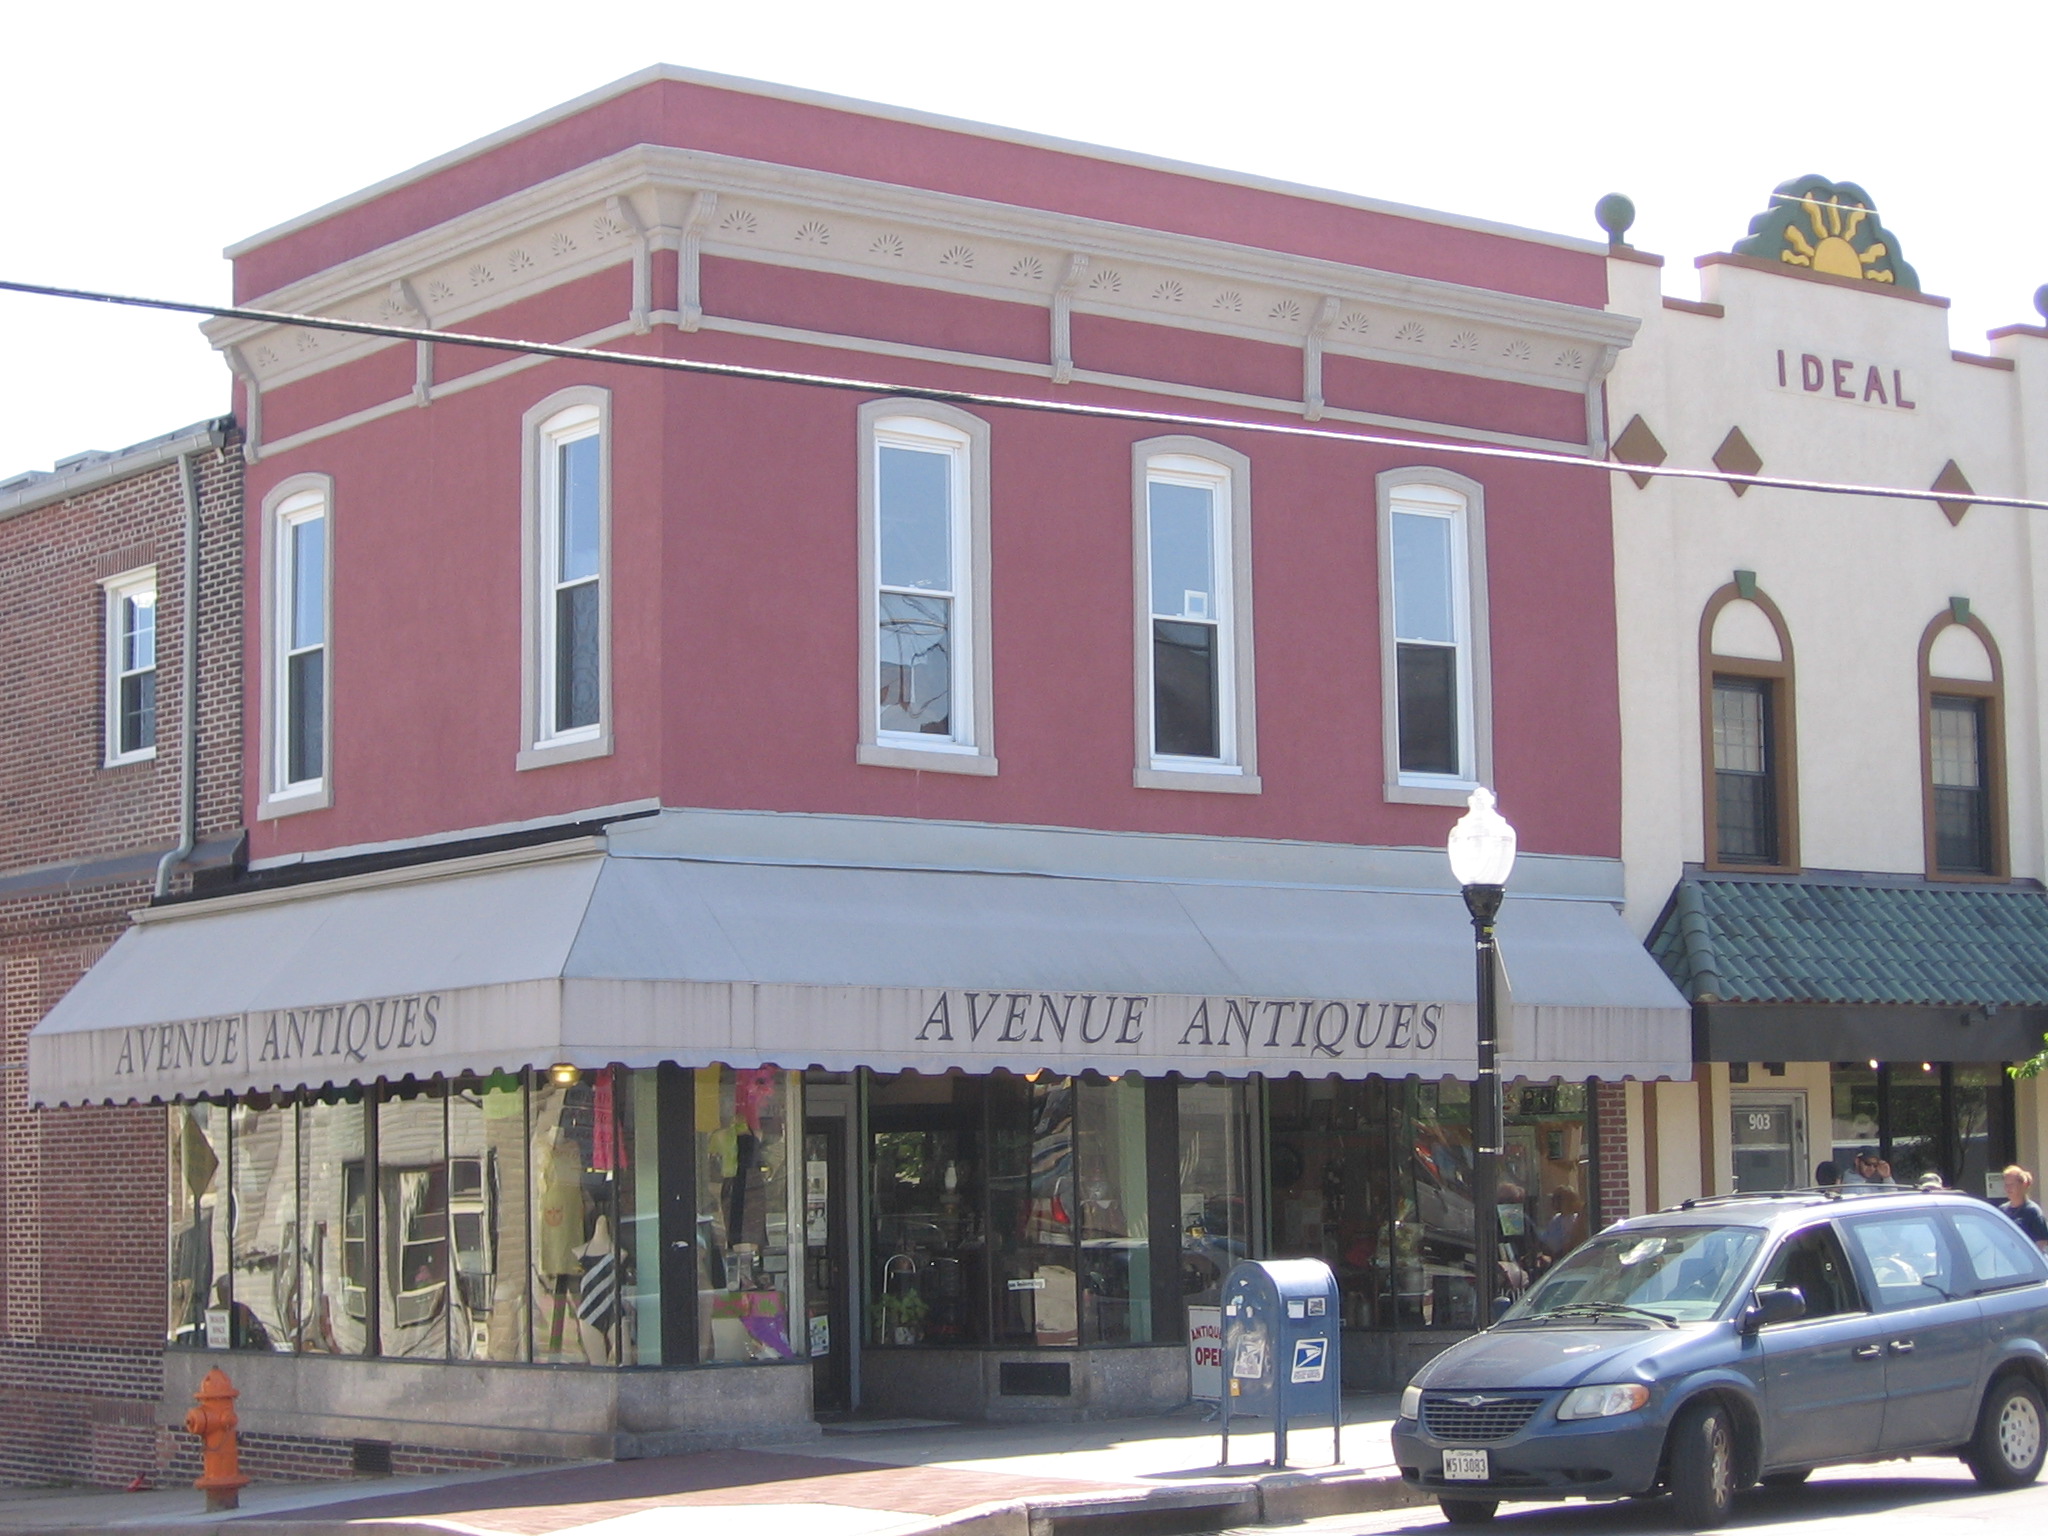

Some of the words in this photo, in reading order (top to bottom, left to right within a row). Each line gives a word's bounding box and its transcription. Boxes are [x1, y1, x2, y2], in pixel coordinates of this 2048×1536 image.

[1777, 349, 1916, 410] IDEAL
[114, 1015, 241, 1075] AVENUE
[258, 995, 441, 1063] ANTIQUES
[915, 991, 1149, 1043] AVENUE
[1178, 997, 1444, 1057] ANTIQUES
[1749, 1113, 1771, 1130] 903
